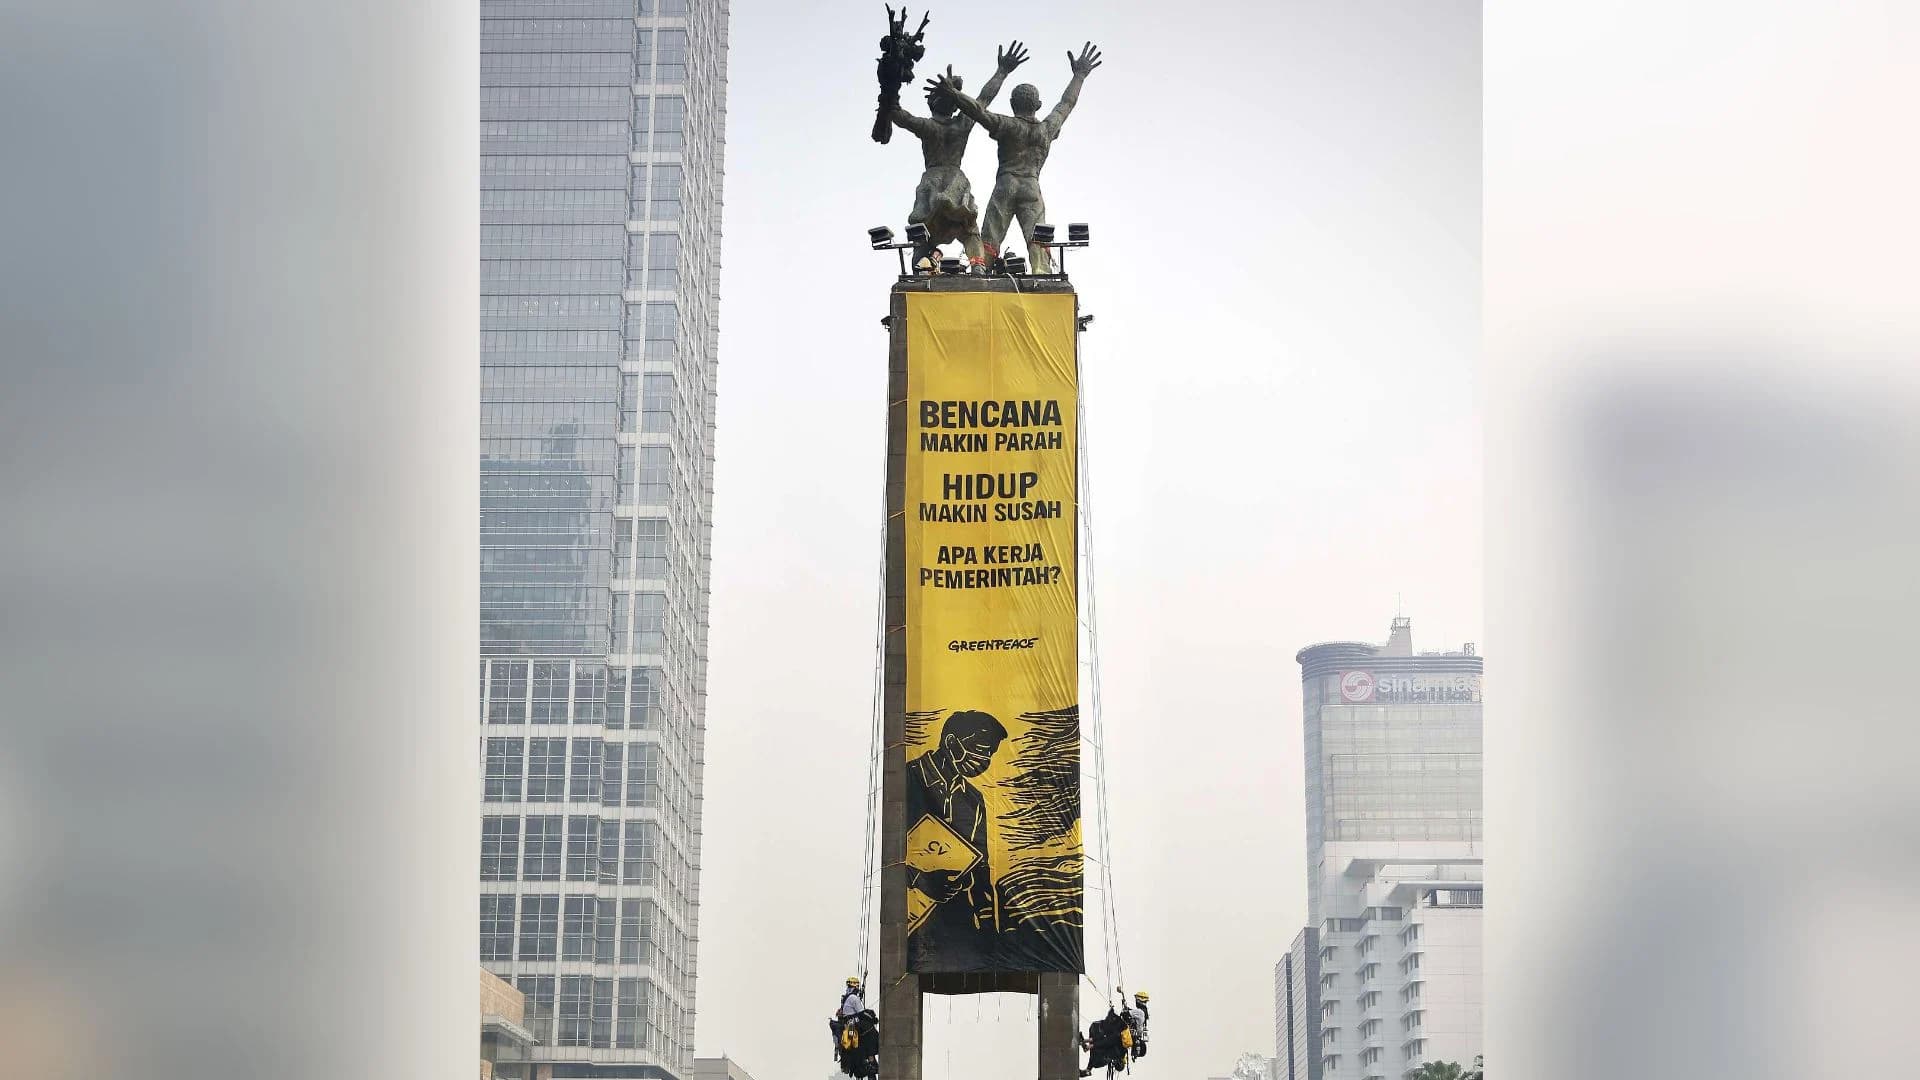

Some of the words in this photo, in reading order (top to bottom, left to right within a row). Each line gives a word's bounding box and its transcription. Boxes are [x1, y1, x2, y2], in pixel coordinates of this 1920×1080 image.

[920, 400, 1062, 429] BENCANA
[921, 432, 988, 452] MAKIN
[995, 431, 1062, 451] PARAH
[943, 472, 1039, 500] HIDUP
[919, 502, 987, 523] MAKIN
[994, 501, 1061, 521] SUSAH
[937, 546, 977, 565] APA
[984, 543, 1043, 564] KERJA
[920, 566, 1061, 589] PEMERINTAH?
[948, 638, 1038, 651] GREENPEACE
